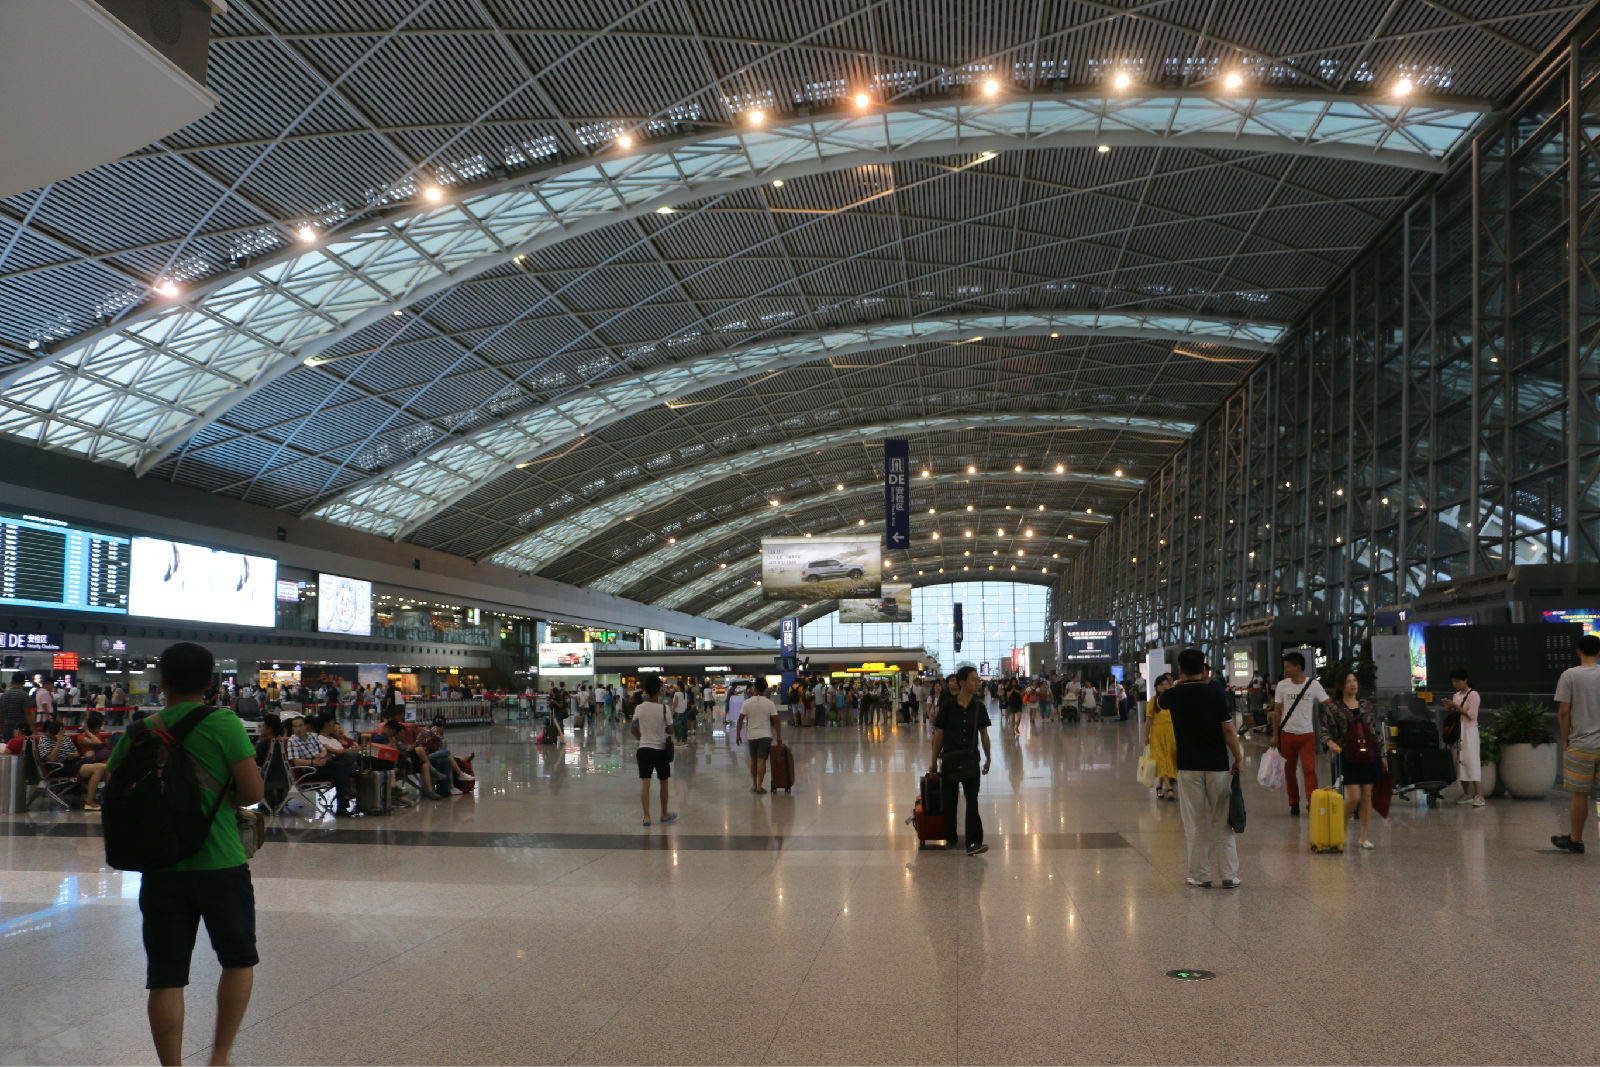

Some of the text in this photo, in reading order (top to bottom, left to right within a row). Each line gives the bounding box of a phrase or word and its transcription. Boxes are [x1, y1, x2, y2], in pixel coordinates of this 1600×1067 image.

[889, 474, 905, 485] DE
[1398, 611, 1406, 621] 11
[9, 633, 26, 648] DE
[27, 634, 48, 643] 安检区
